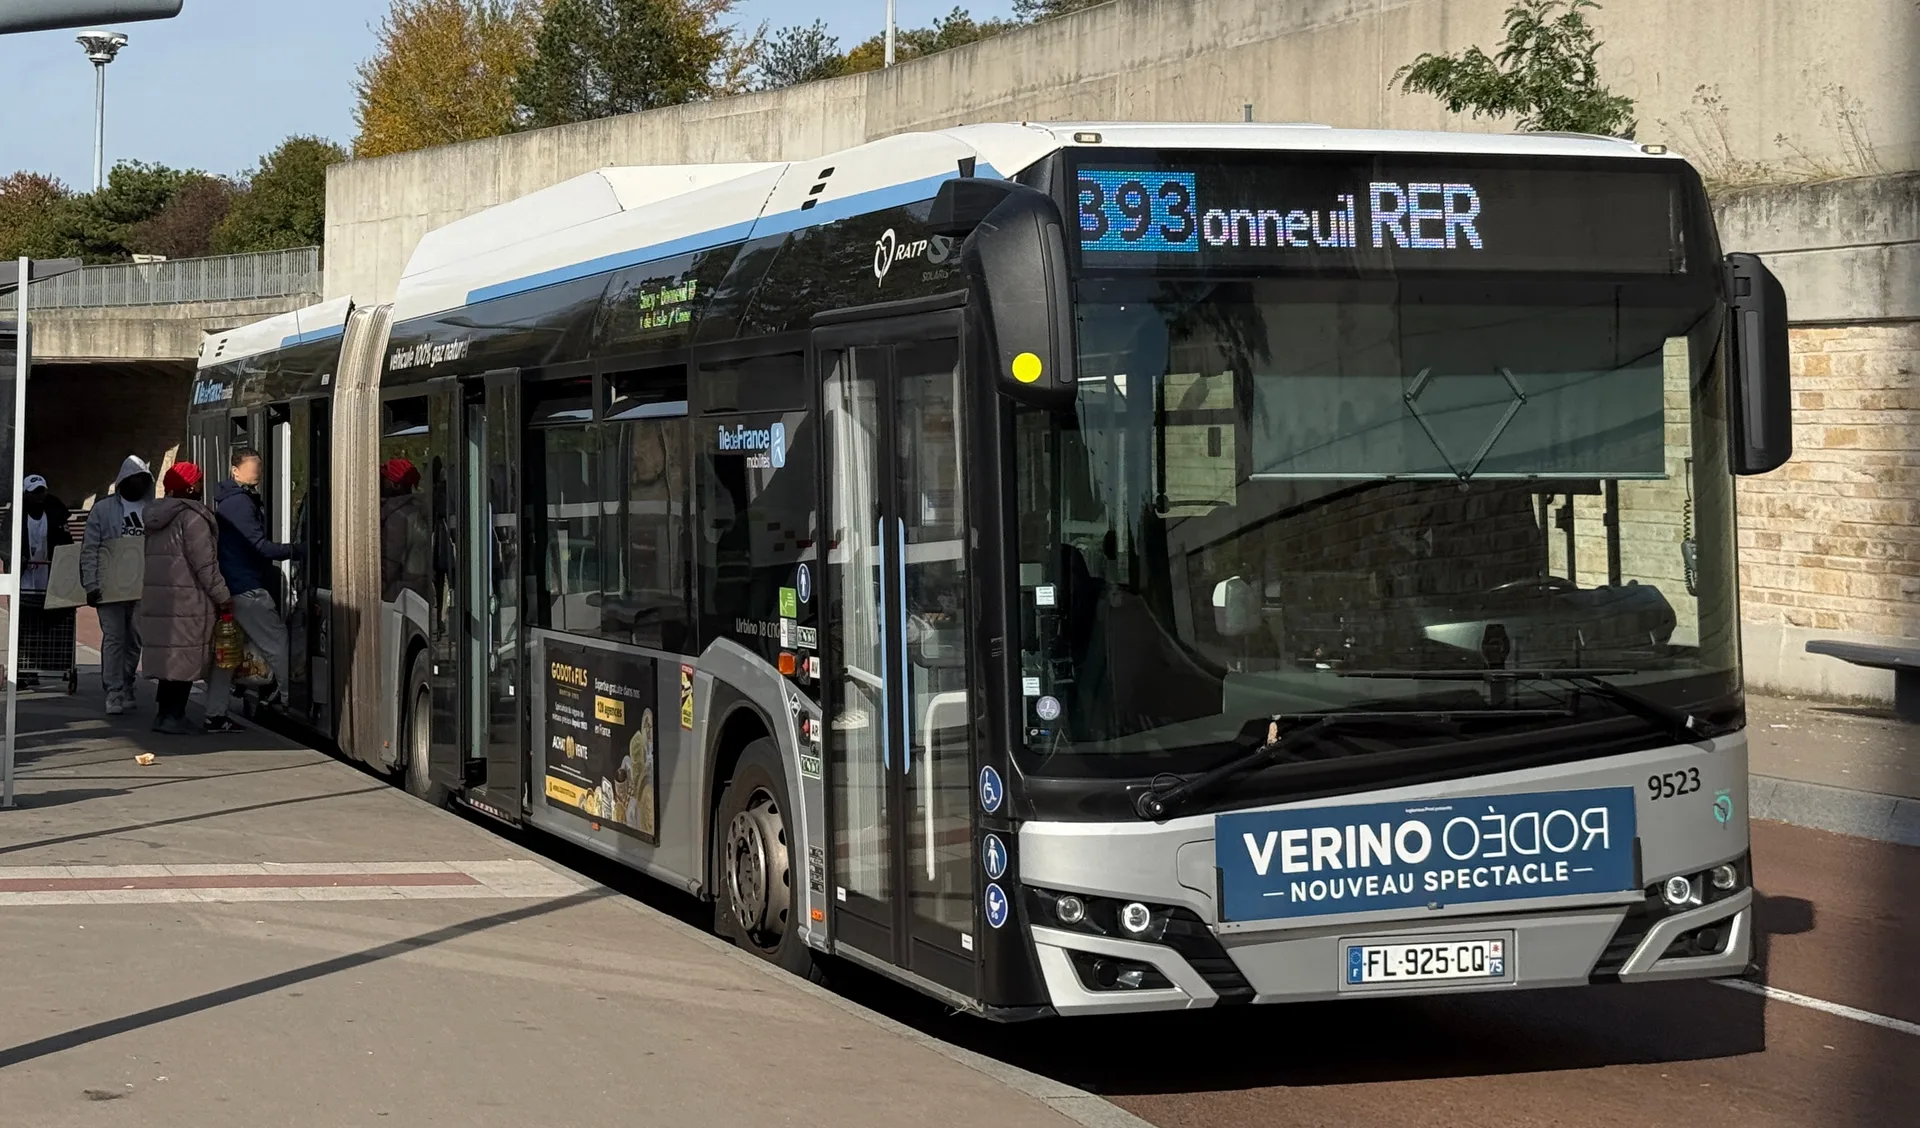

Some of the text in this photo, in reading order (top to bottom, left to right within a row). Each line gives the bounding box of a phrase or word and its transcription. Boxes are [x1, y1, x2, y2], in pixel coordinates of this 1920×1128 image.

[1369, 182, 1483, 249] RER
[895, 239, 928, 261] RATP
[414, 341, 434, 367] 100%
[430, 344, 446, 369] gaz
[444, 335, 471, 362] naturel
[735, 618, 758, 635] Urbino
[759, 621, 767, 637] 18
[551, 662, 572, 683] GODOT
[574, 667, 588, 687] FILS
[575, 743, 588, 760] VENTE
[1647, 766, 1701, 801] 9523
[1243, 819, 1432, 876] VERINO
[1290, 861, 1569, 903] NOUVEAU SPECTACLE
[1352, 968, 1359, 977] F
[1490, 959, 1502, 973] 75
